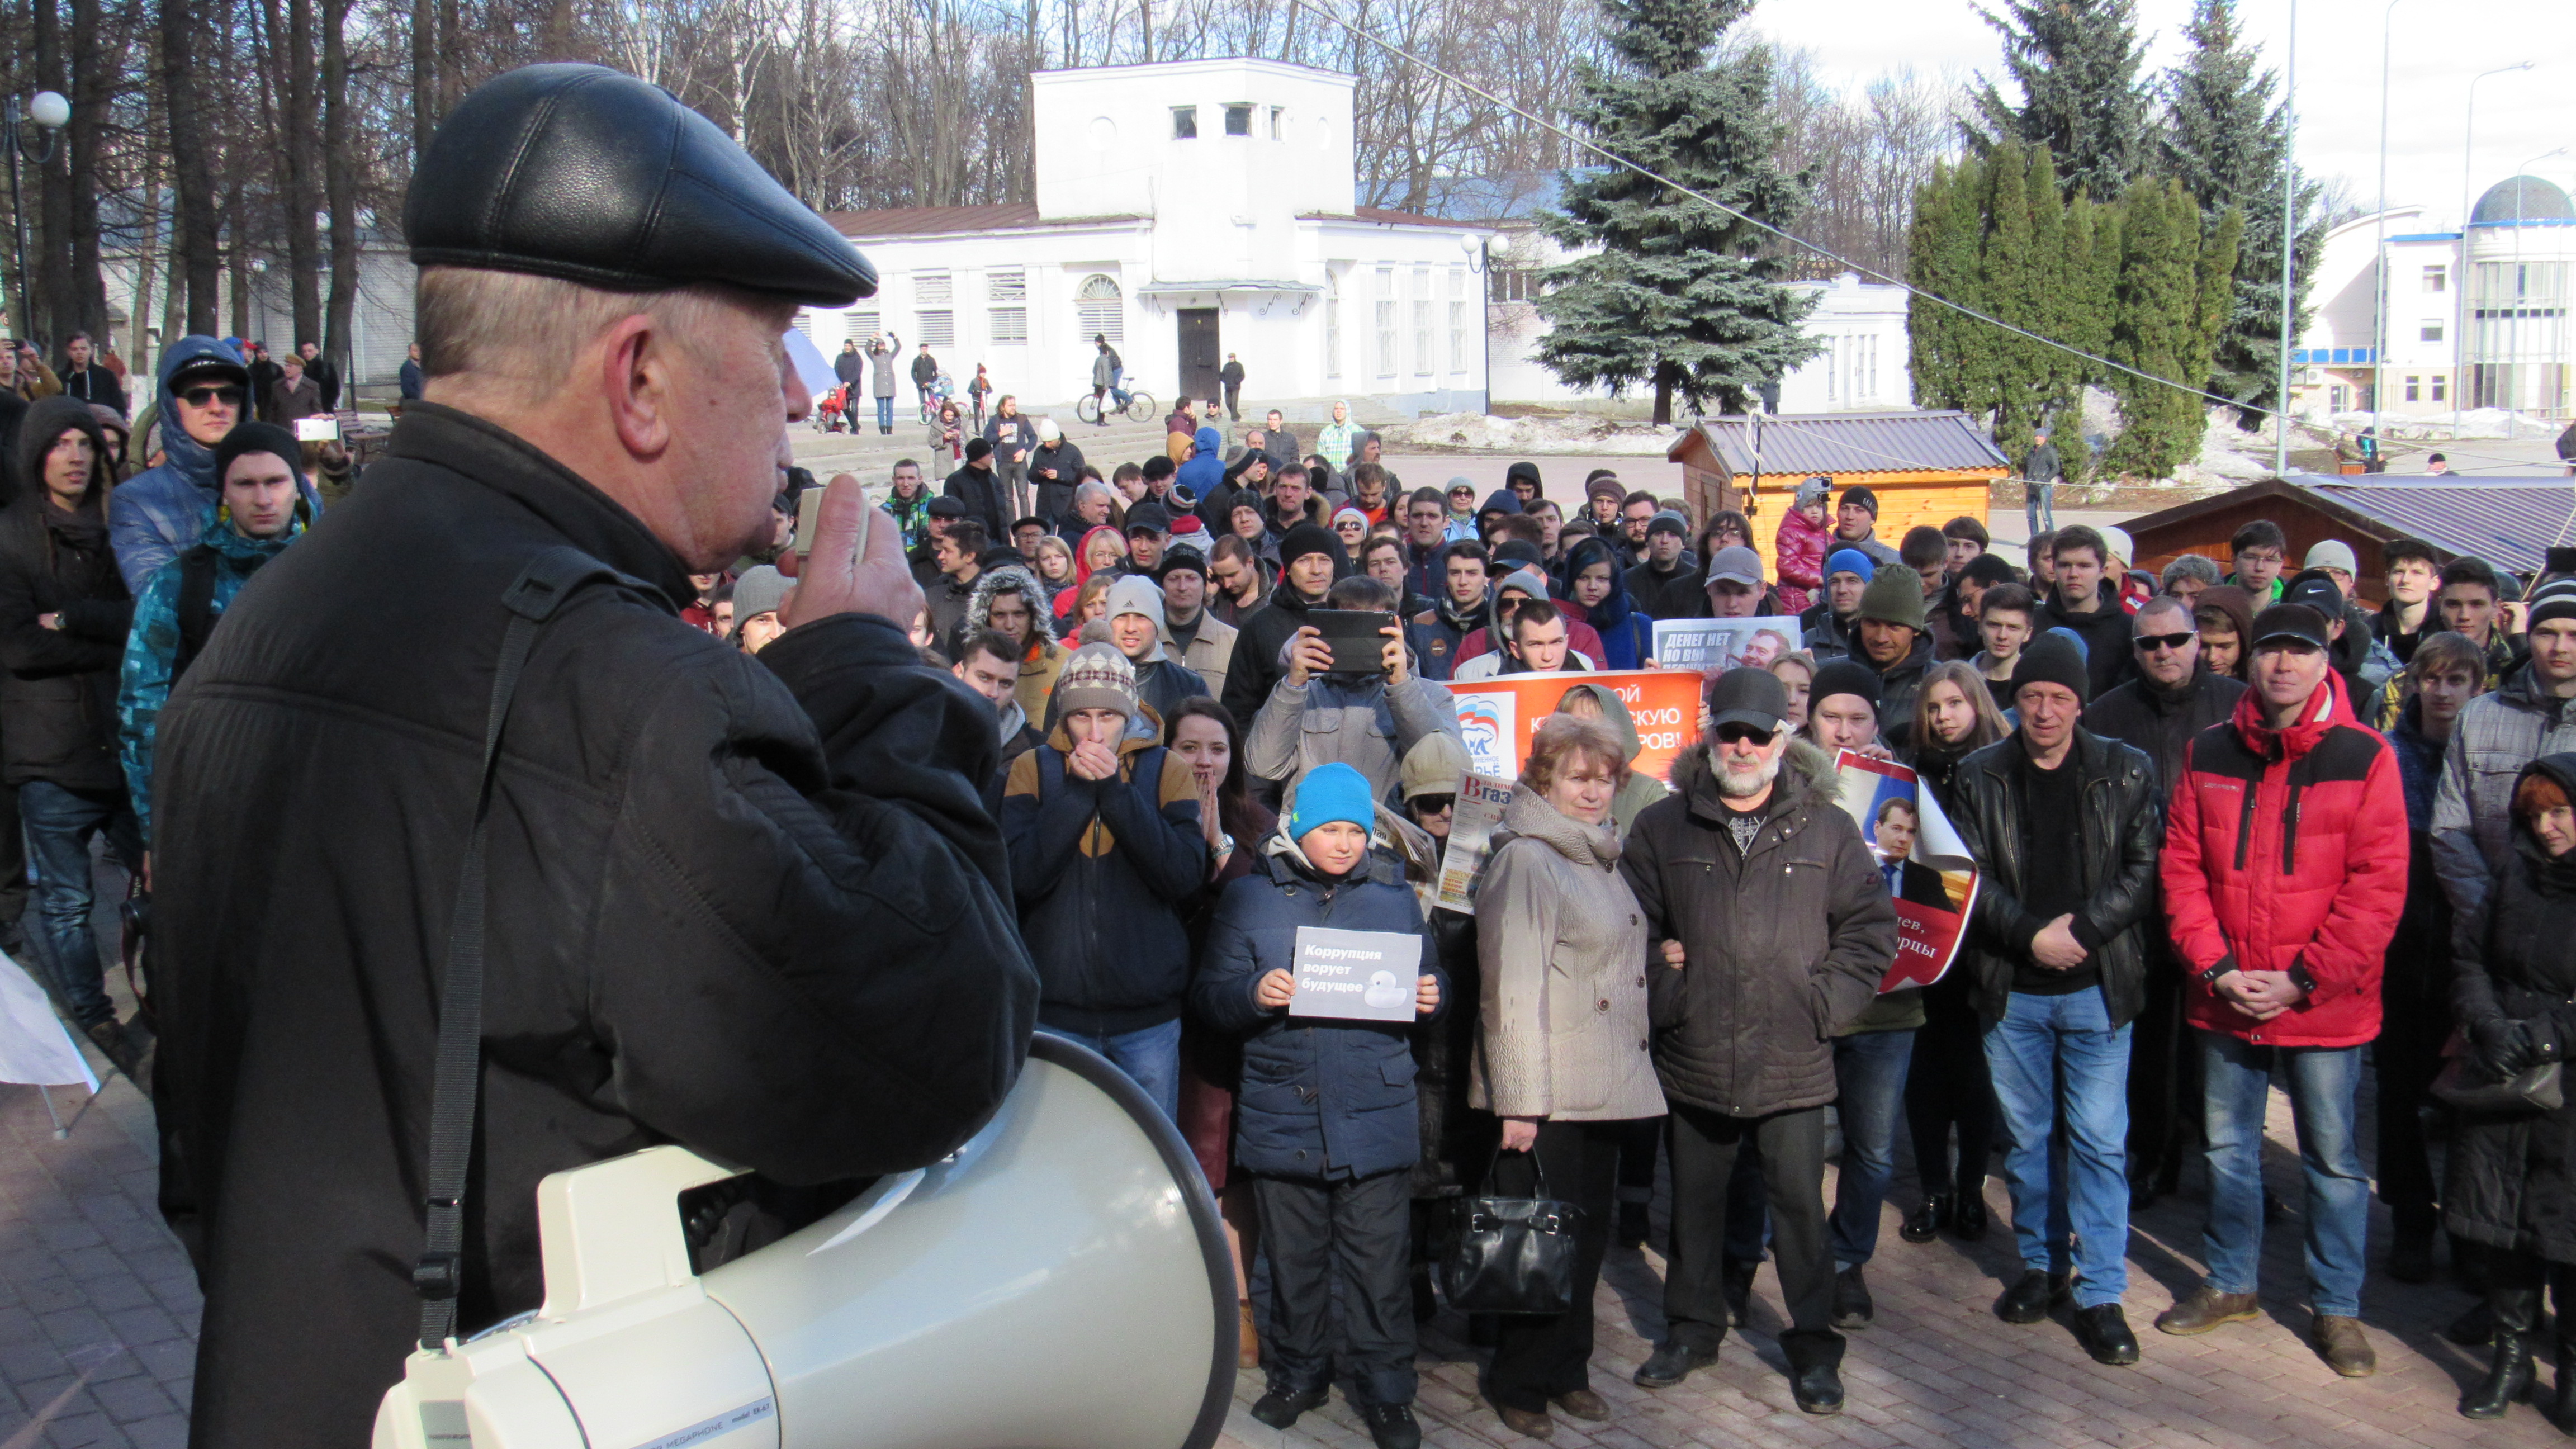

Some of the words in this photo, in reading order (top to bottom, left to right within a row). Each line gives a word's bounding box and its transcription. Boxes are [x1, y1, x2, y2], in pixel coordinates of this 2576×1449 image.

[1665, 633, 1705, 648] ДЕНЕГ
[1707, 633, 1731, 646] НЕТ
[1662, 649, 1680, 662] НО
[1682, 648, 1705, 661] ВЫ
[1305, 944, 1382, 960] Коррупция
[1896, 936, 1936, 959] рцы
[1303, 963, 1352, 976] ворует
[1301, 977, 1363, 993] будущее
[666, 1422, 723, 1449] MEGAPHONE
